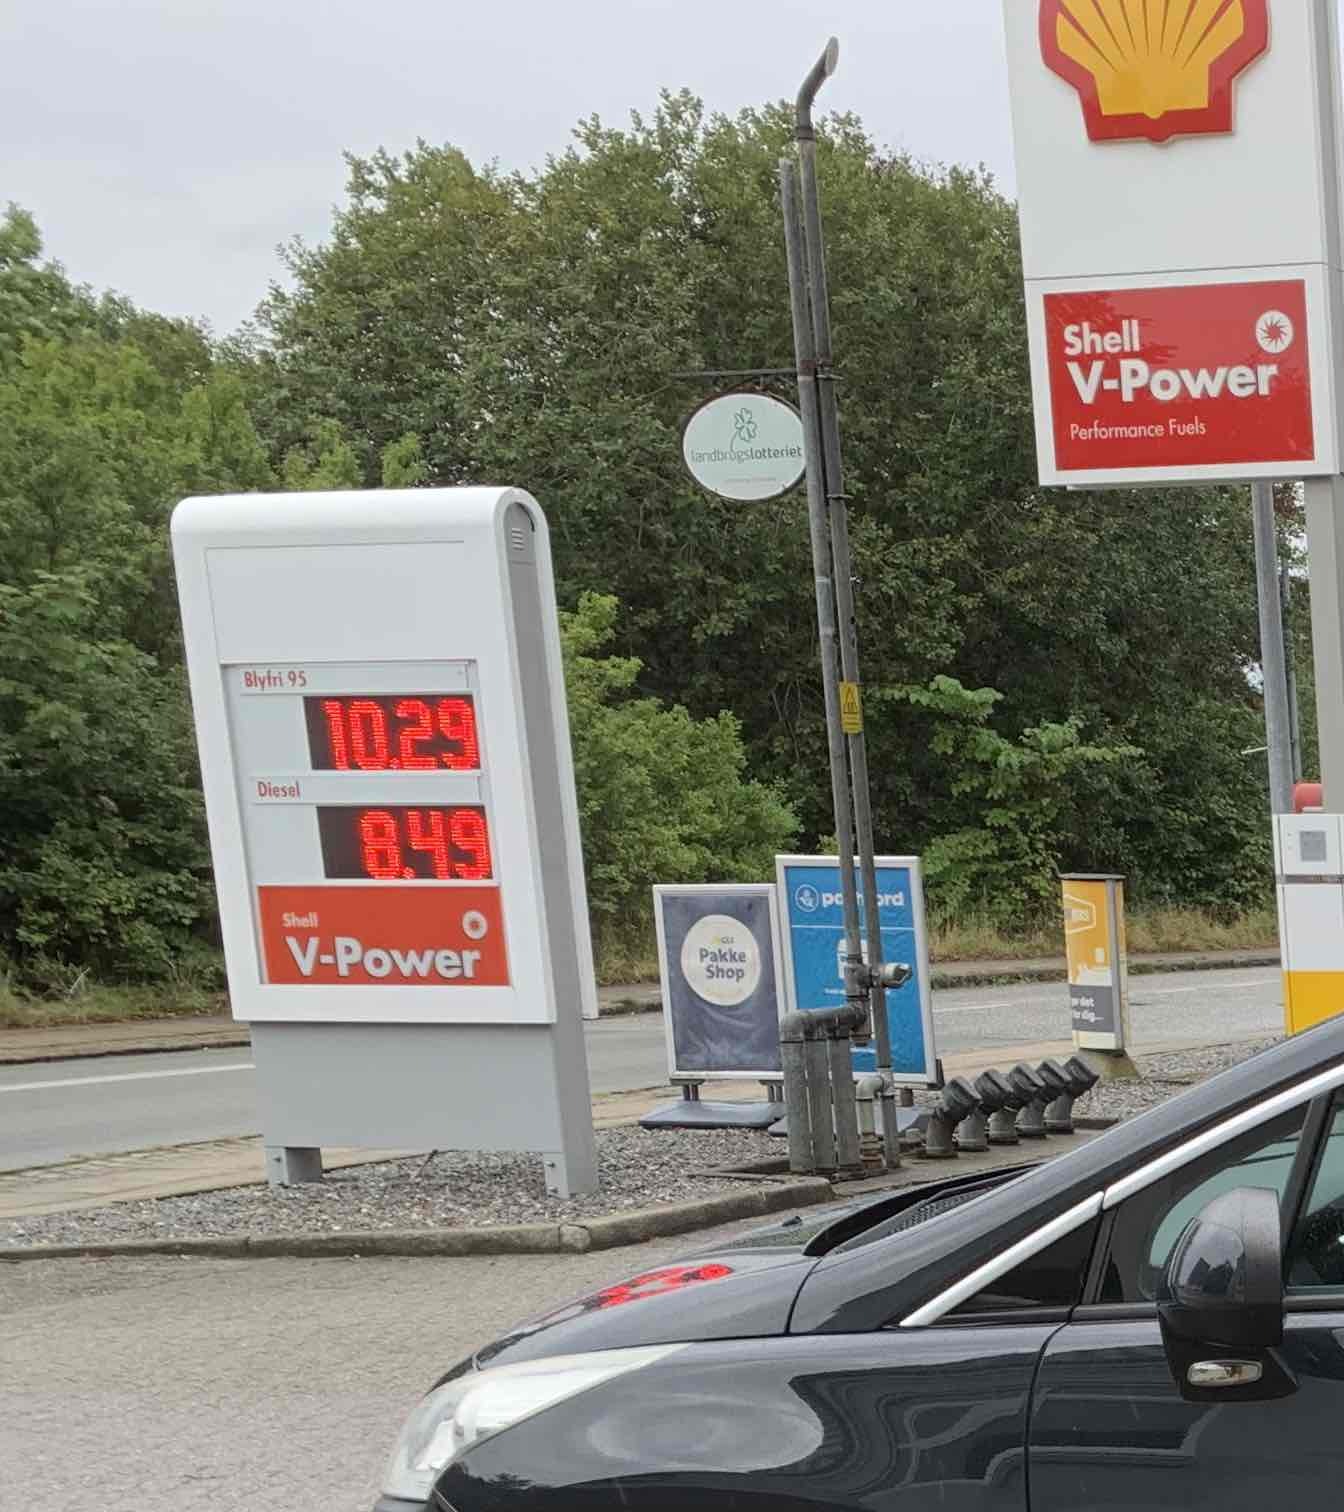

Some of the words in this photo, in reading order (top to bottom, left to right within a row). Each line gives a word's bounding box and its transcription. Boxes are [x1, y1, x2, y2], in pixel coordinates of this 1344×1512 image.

[1063, 319, 1140, 355] Shell
[1066, 358, 1278, 404] V-Power
[1070, 419, 1164, 440] Performance
[1169, 415, 1206, 436] Fuels
[244, 668, 284, 691] Blyfri
[288, 671, 307, 687] 95
[257, 780, 300, 798] Diesel
[359, 810, 492, 880] 8.49
[283, 911, 319, 928] Shell
[285, 935, 481, 978] V-Power
[699, 947, 747, 963] Pakke
[705, 963, 745, 983] Shop
